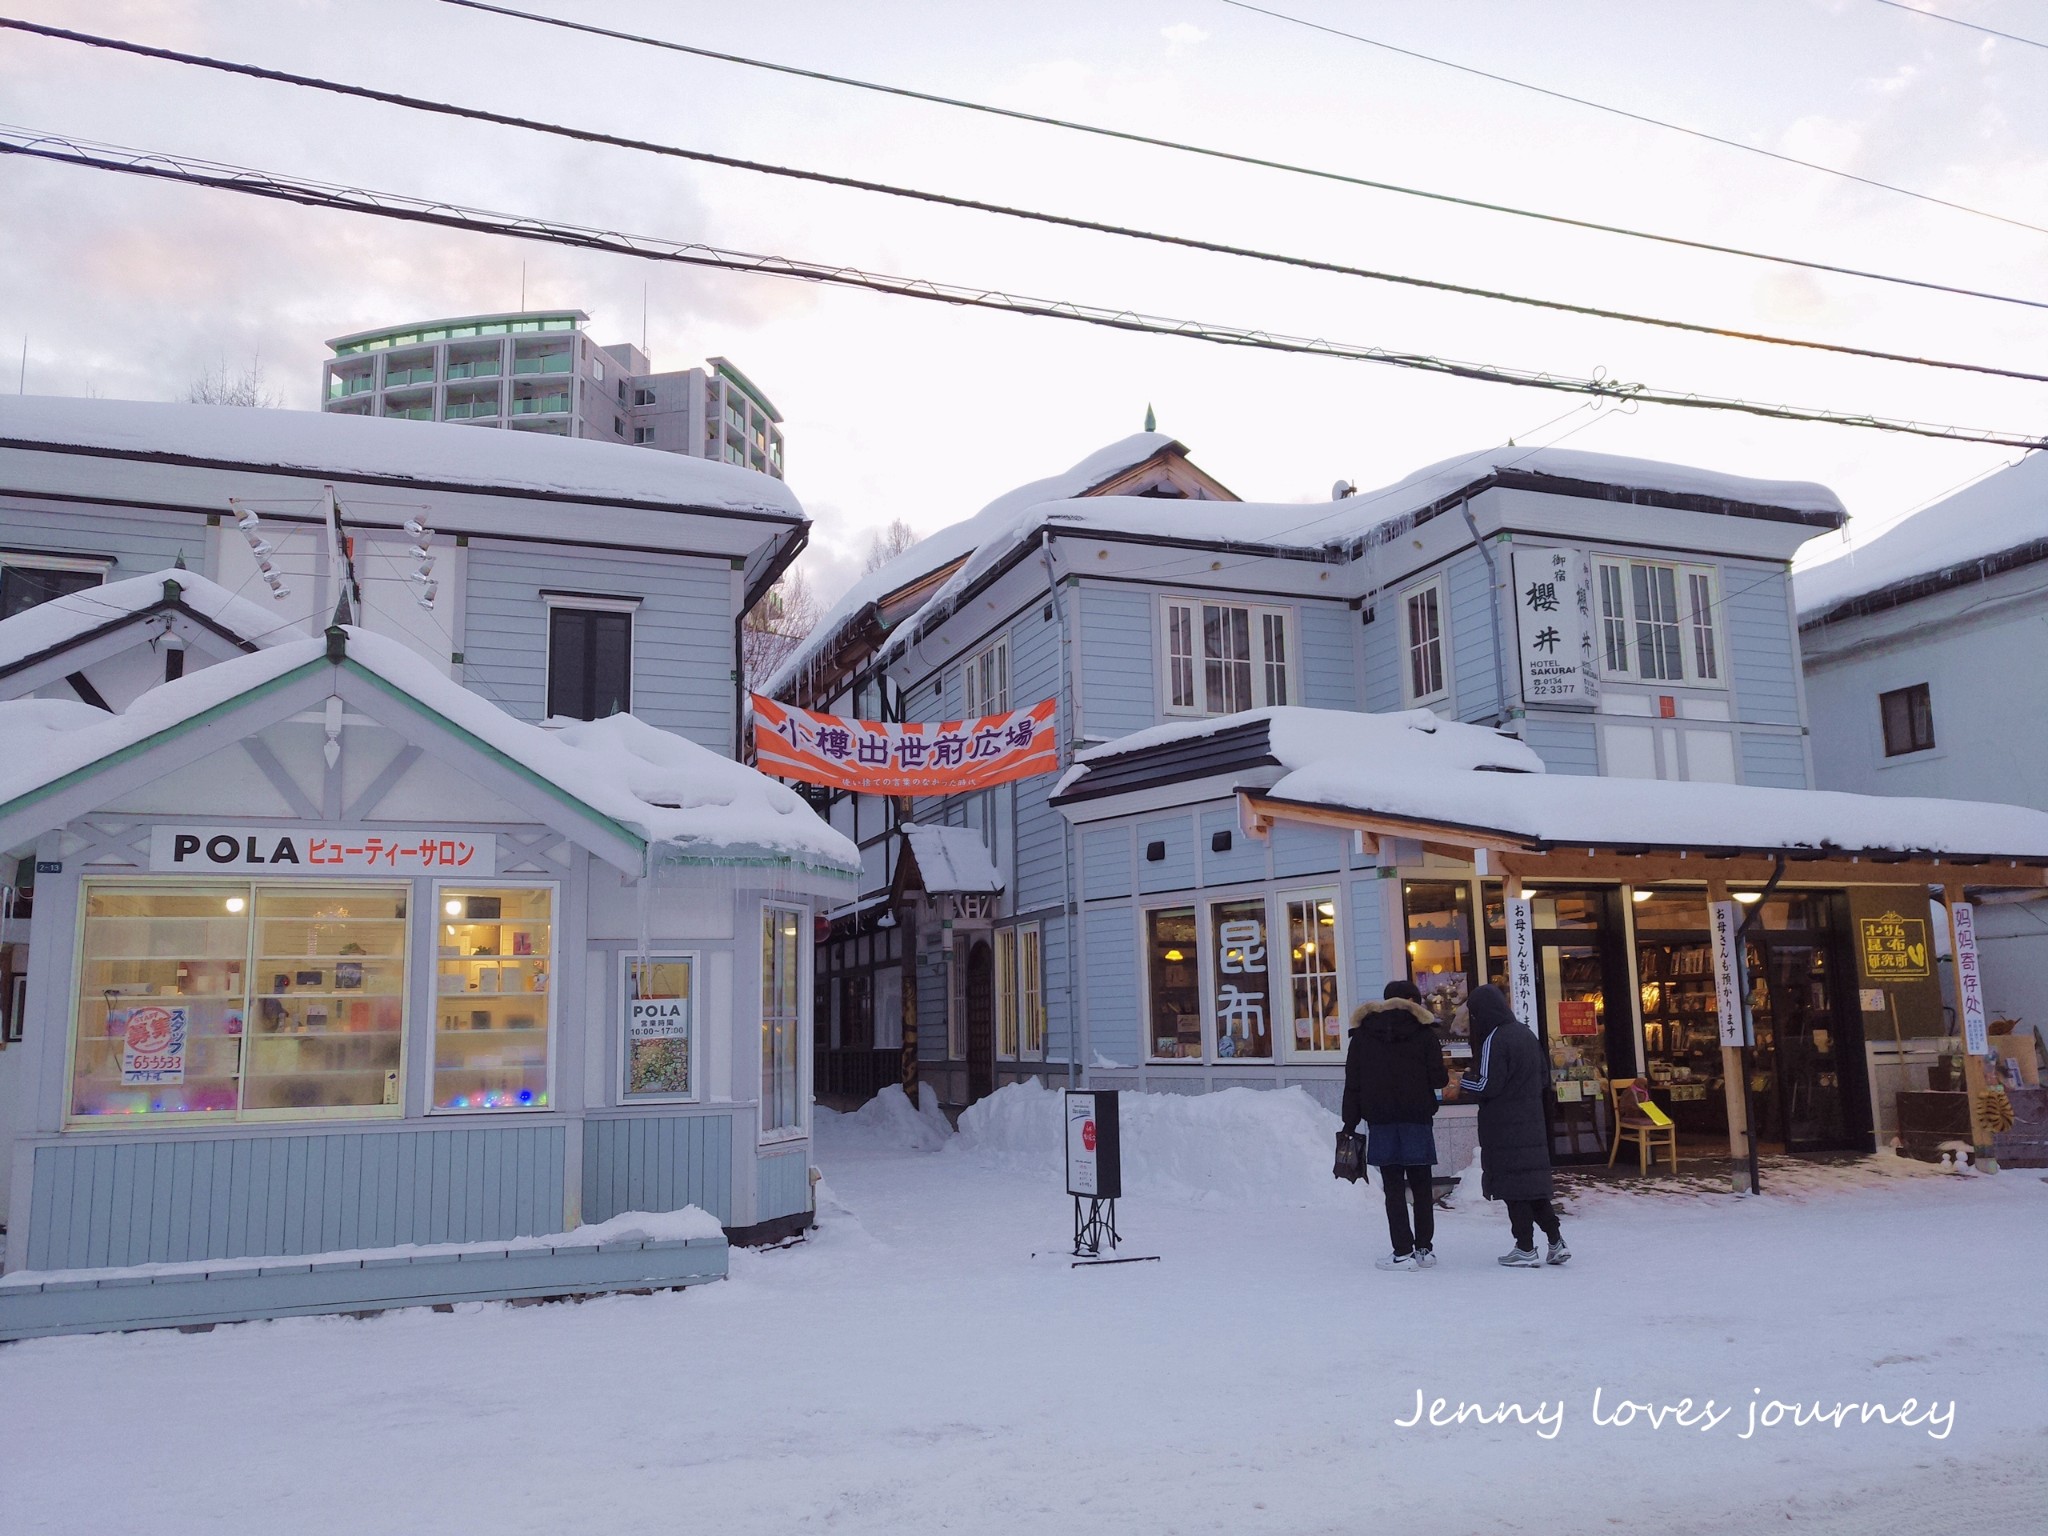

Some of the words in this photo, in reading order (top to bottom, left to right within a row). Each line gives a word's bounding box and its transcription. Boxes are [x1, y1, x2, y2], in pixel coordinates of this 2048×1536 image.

[1552, 554, 1566, 582] 御宿
[1530, 659, 1560, 668] HOTEL
[1530, 667, 1576, 676] SAKURAI
[1534, 685, 1575, 695] 22-3377
[778, 717, 1036, 768] 小樽出世前広場
[173, 833, 301, 864] POLA
[308, 837, 475, 867] ビューティーサロン
[1867, 938, 1906, 951] 昆布
[1955, 908, 1982, 1015] 妈妈寄存处
[1217, 919, 1267, 1040] 昆布
[1716, 908, 1736, 1039] お母さんも預かります
[633, 1004, 681, 1017] POLA
[169, 1010, 185, 1053] スタッフ
[640, 1018, 674, 1027] 営業時間
[133, 1055, 182, 1069] 65-5533
